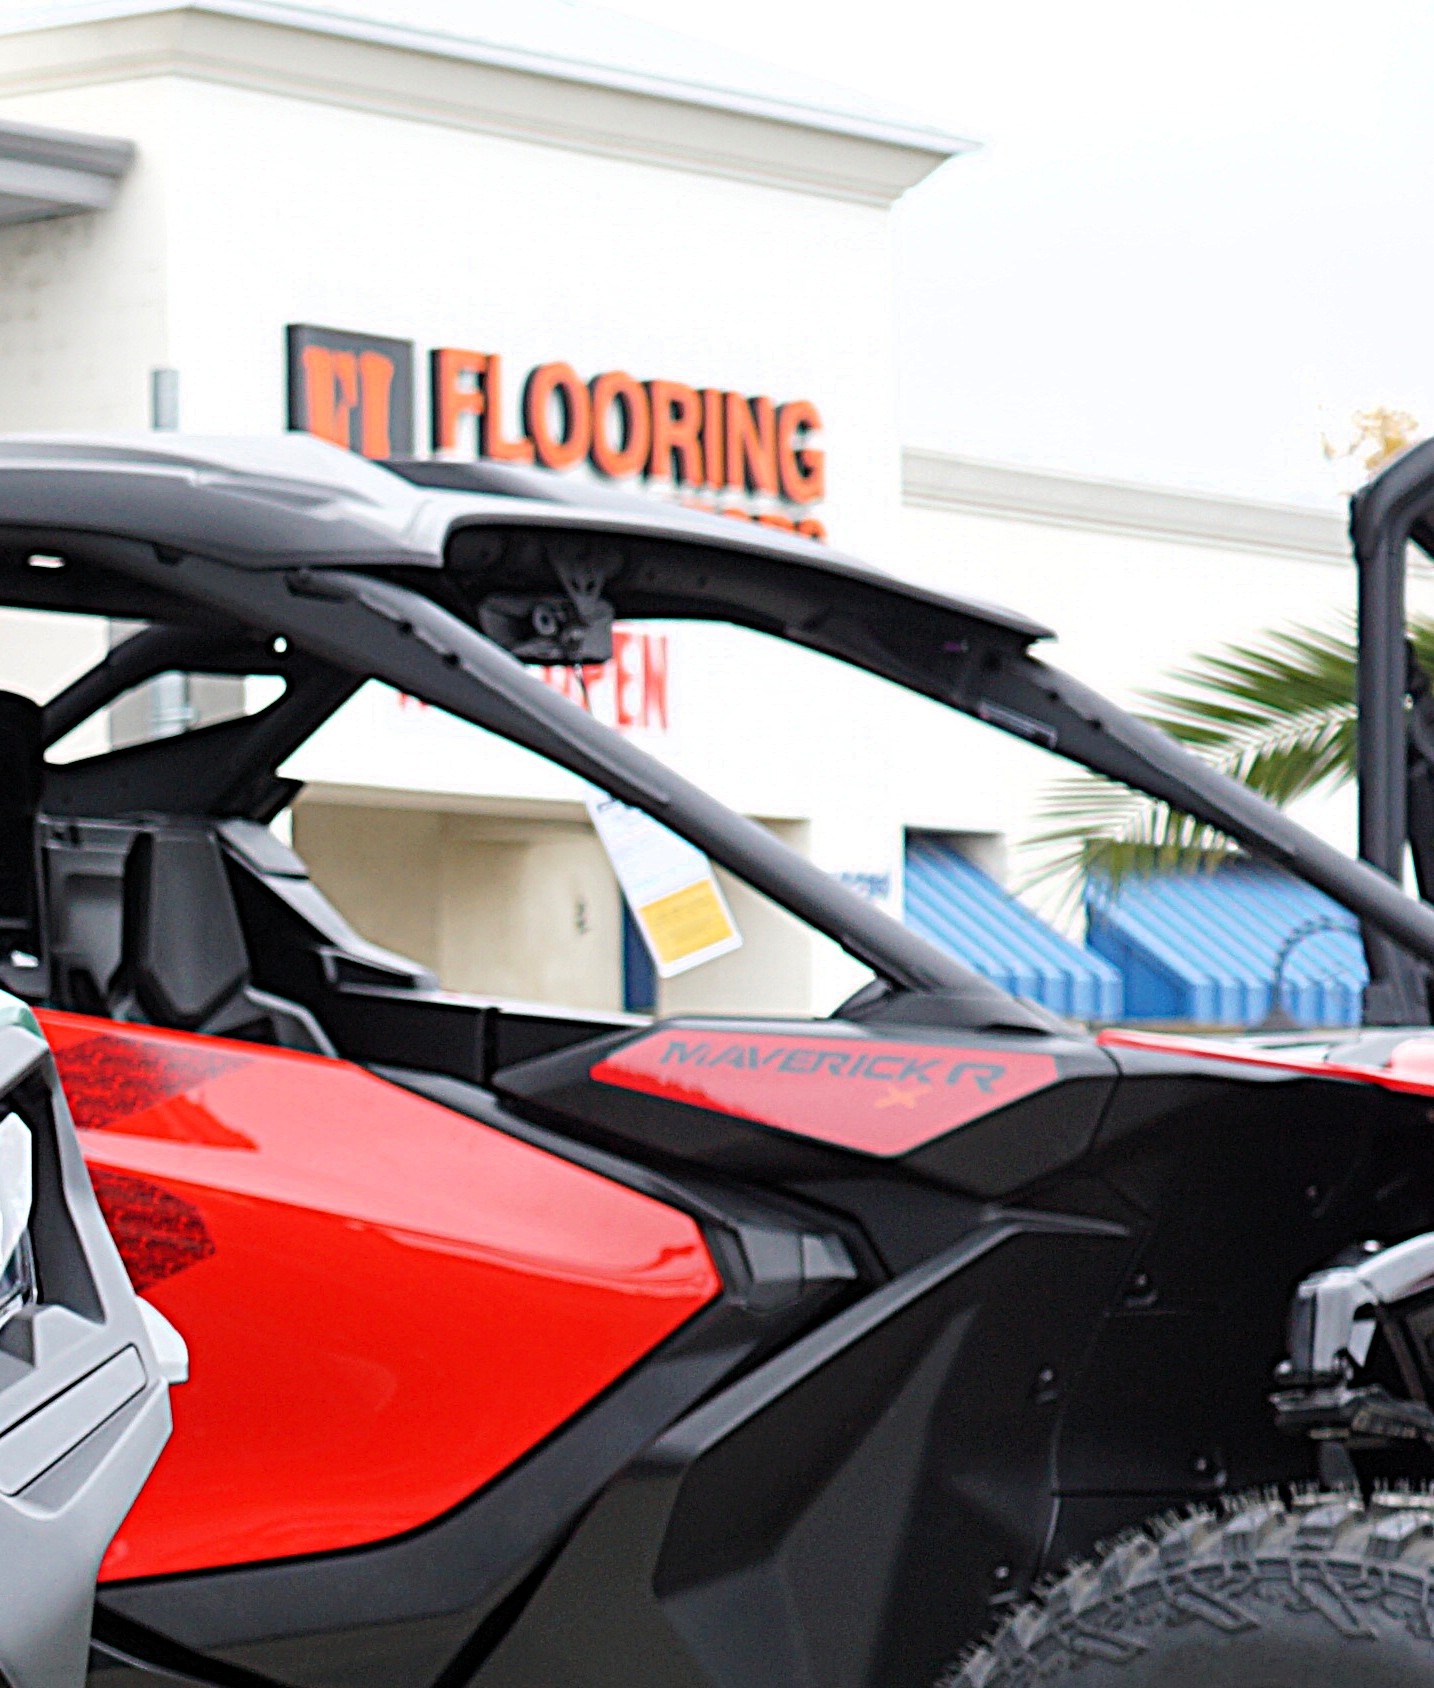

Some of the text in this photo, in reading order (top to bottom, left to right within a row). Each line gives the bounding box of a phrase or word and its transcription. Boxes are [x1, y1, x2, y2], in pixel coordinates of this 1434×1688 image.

[432, 346, 826, 505] FLOORING
[660, 1040, 1008, 1095] MAVERICK R
